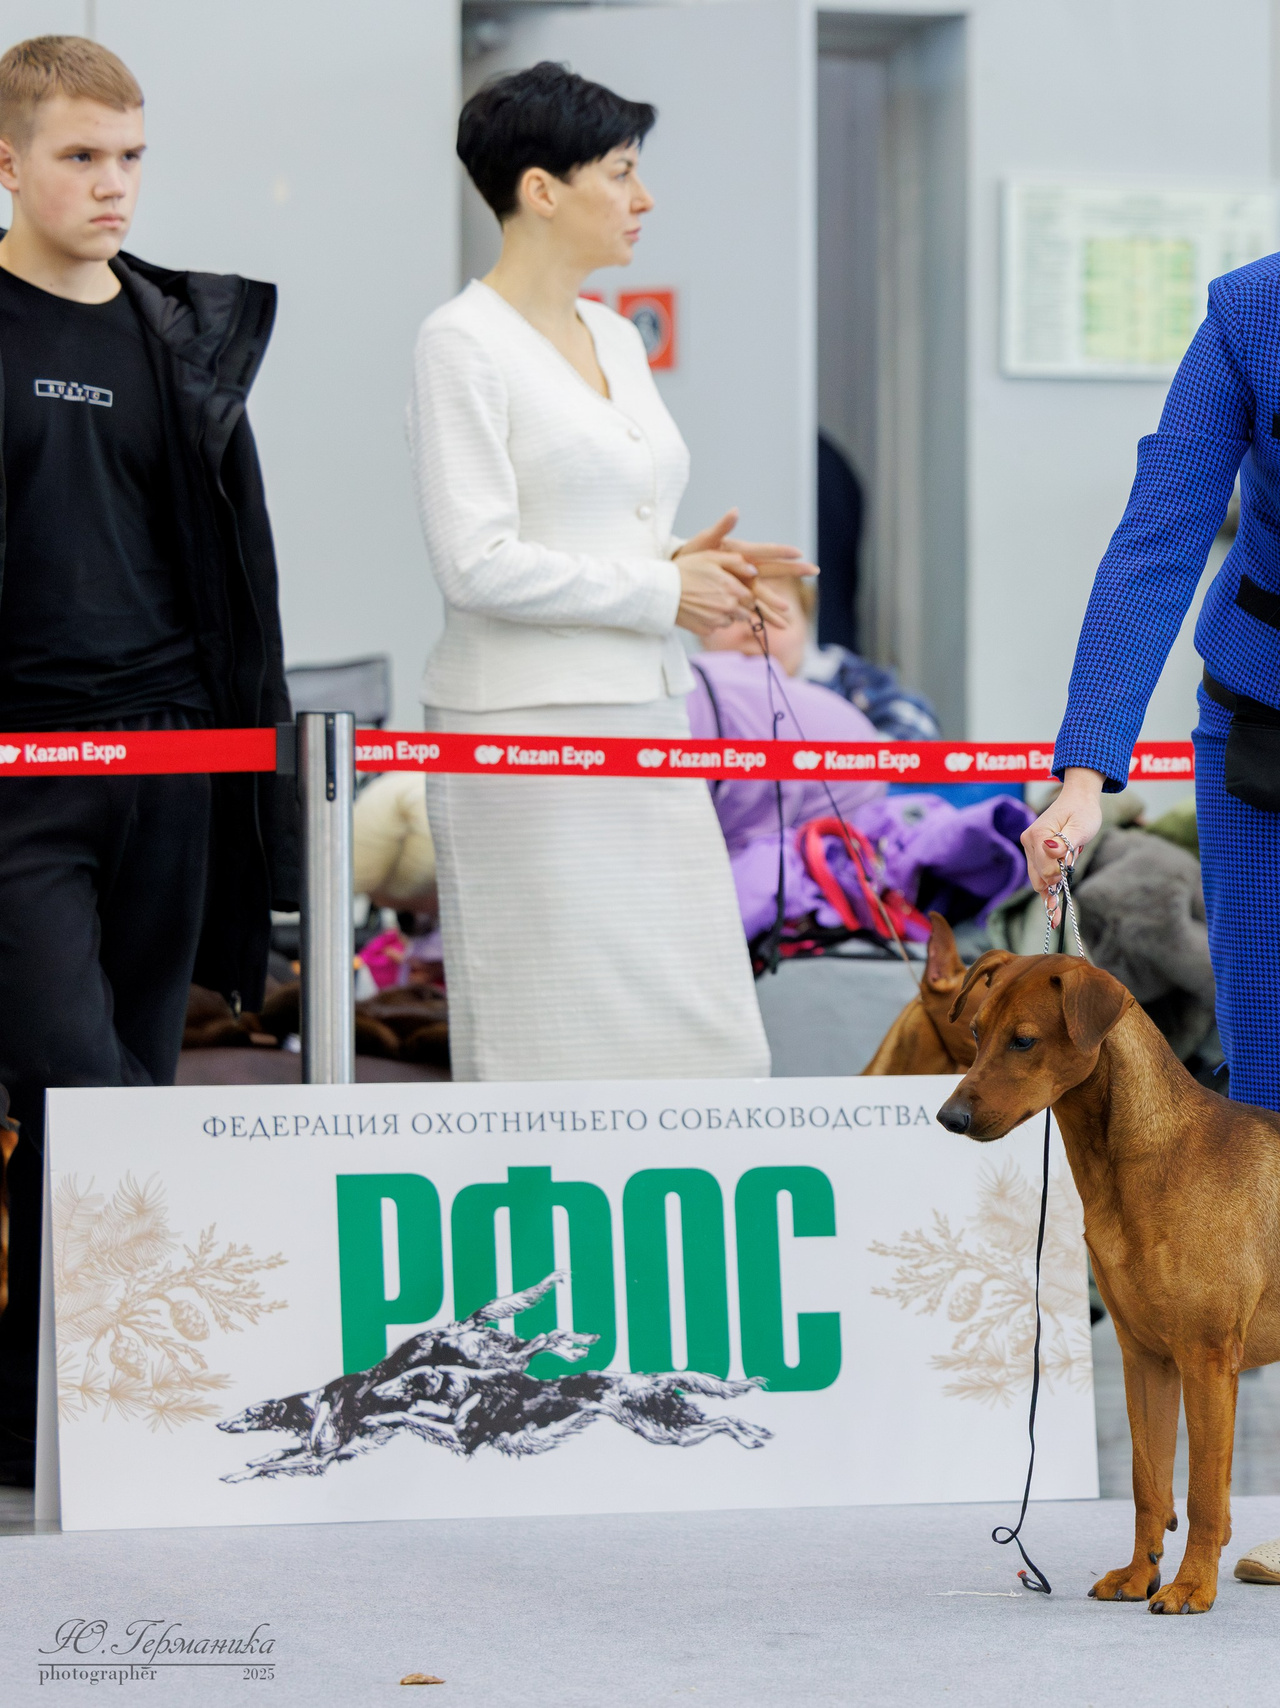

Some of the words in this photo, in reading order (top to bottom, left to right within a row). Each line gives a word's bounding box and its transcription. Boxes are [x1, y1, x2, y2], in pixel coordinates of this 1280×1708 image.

[25, 743, 79, 763] Kazan
[82, 741, 126, 765] Expo
[355, 744, 393, 762] azan
[395, 741, 440, 764] Expo
[507, 745, 559, 765] Kazan
[561, 746, 605, 770] Expo
[669, 749, 721, 768] Kazan
[723, 749, 766, 772] Expo
[825, 751, 875, 770] Kazan
[878, 750, 920, 774] Expo
[976, 751, 1027, 770] Kazan
[1141, 753, 1190, 773] Kazan
[202, 1113, 400, 1141] ФЕДЕРАЦИЯ
[411, 1109, 648, 1134] ОХОТНИЧЬЕГО
[658, 1105, 932, 1131] СОБАКОВОДСТВА
[336, 1165, 842, 1393] РФОС
